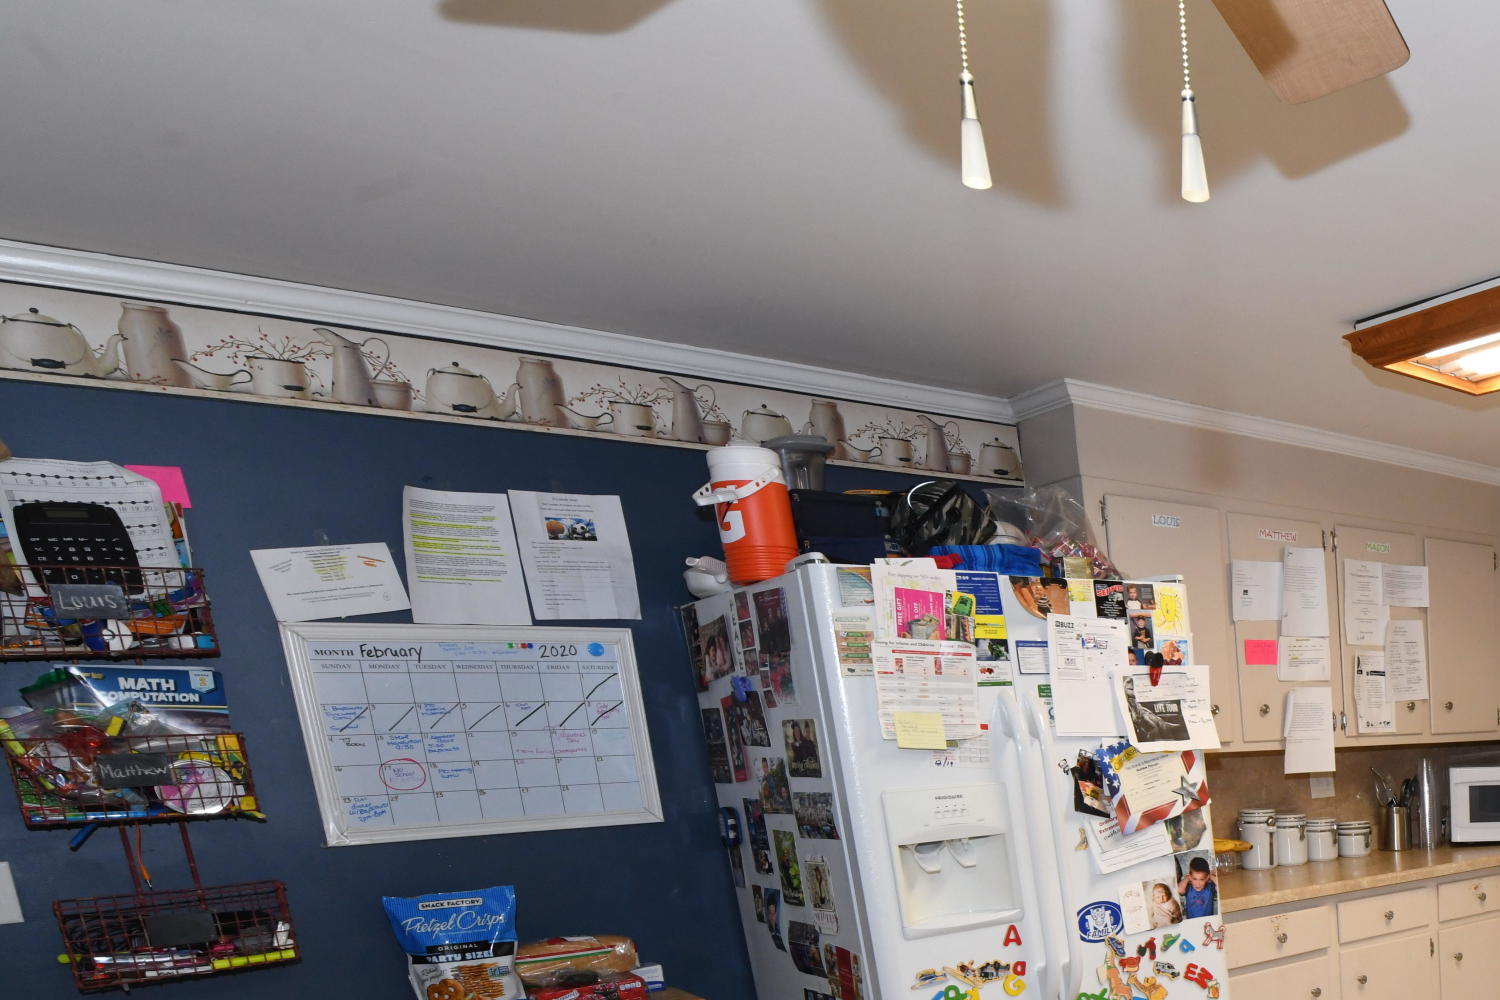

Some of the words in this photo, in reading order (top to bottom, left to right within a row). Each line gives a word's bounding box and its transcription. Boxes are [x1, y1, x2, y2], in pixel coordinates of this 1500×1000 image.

[1258, 528, 1298, 542] MATTHEW
[896, 613, 904, 626] FREE
[314, 649, 354, 657] MONTH
[360, 643, 423, 664] February
[538, 644, 578, 659] 2020
[117, 676, 176, 691] MATH
[420, 901, 446, 909] SNACK
[447, 898, 481, 907] FACTORY
[400, 913, 457, 939] Pretzel
[457, 910, 506, 931] Crisps
[1003, 924, 1023, 947] A
[437, 943, 479, 952] ORIGINAL
